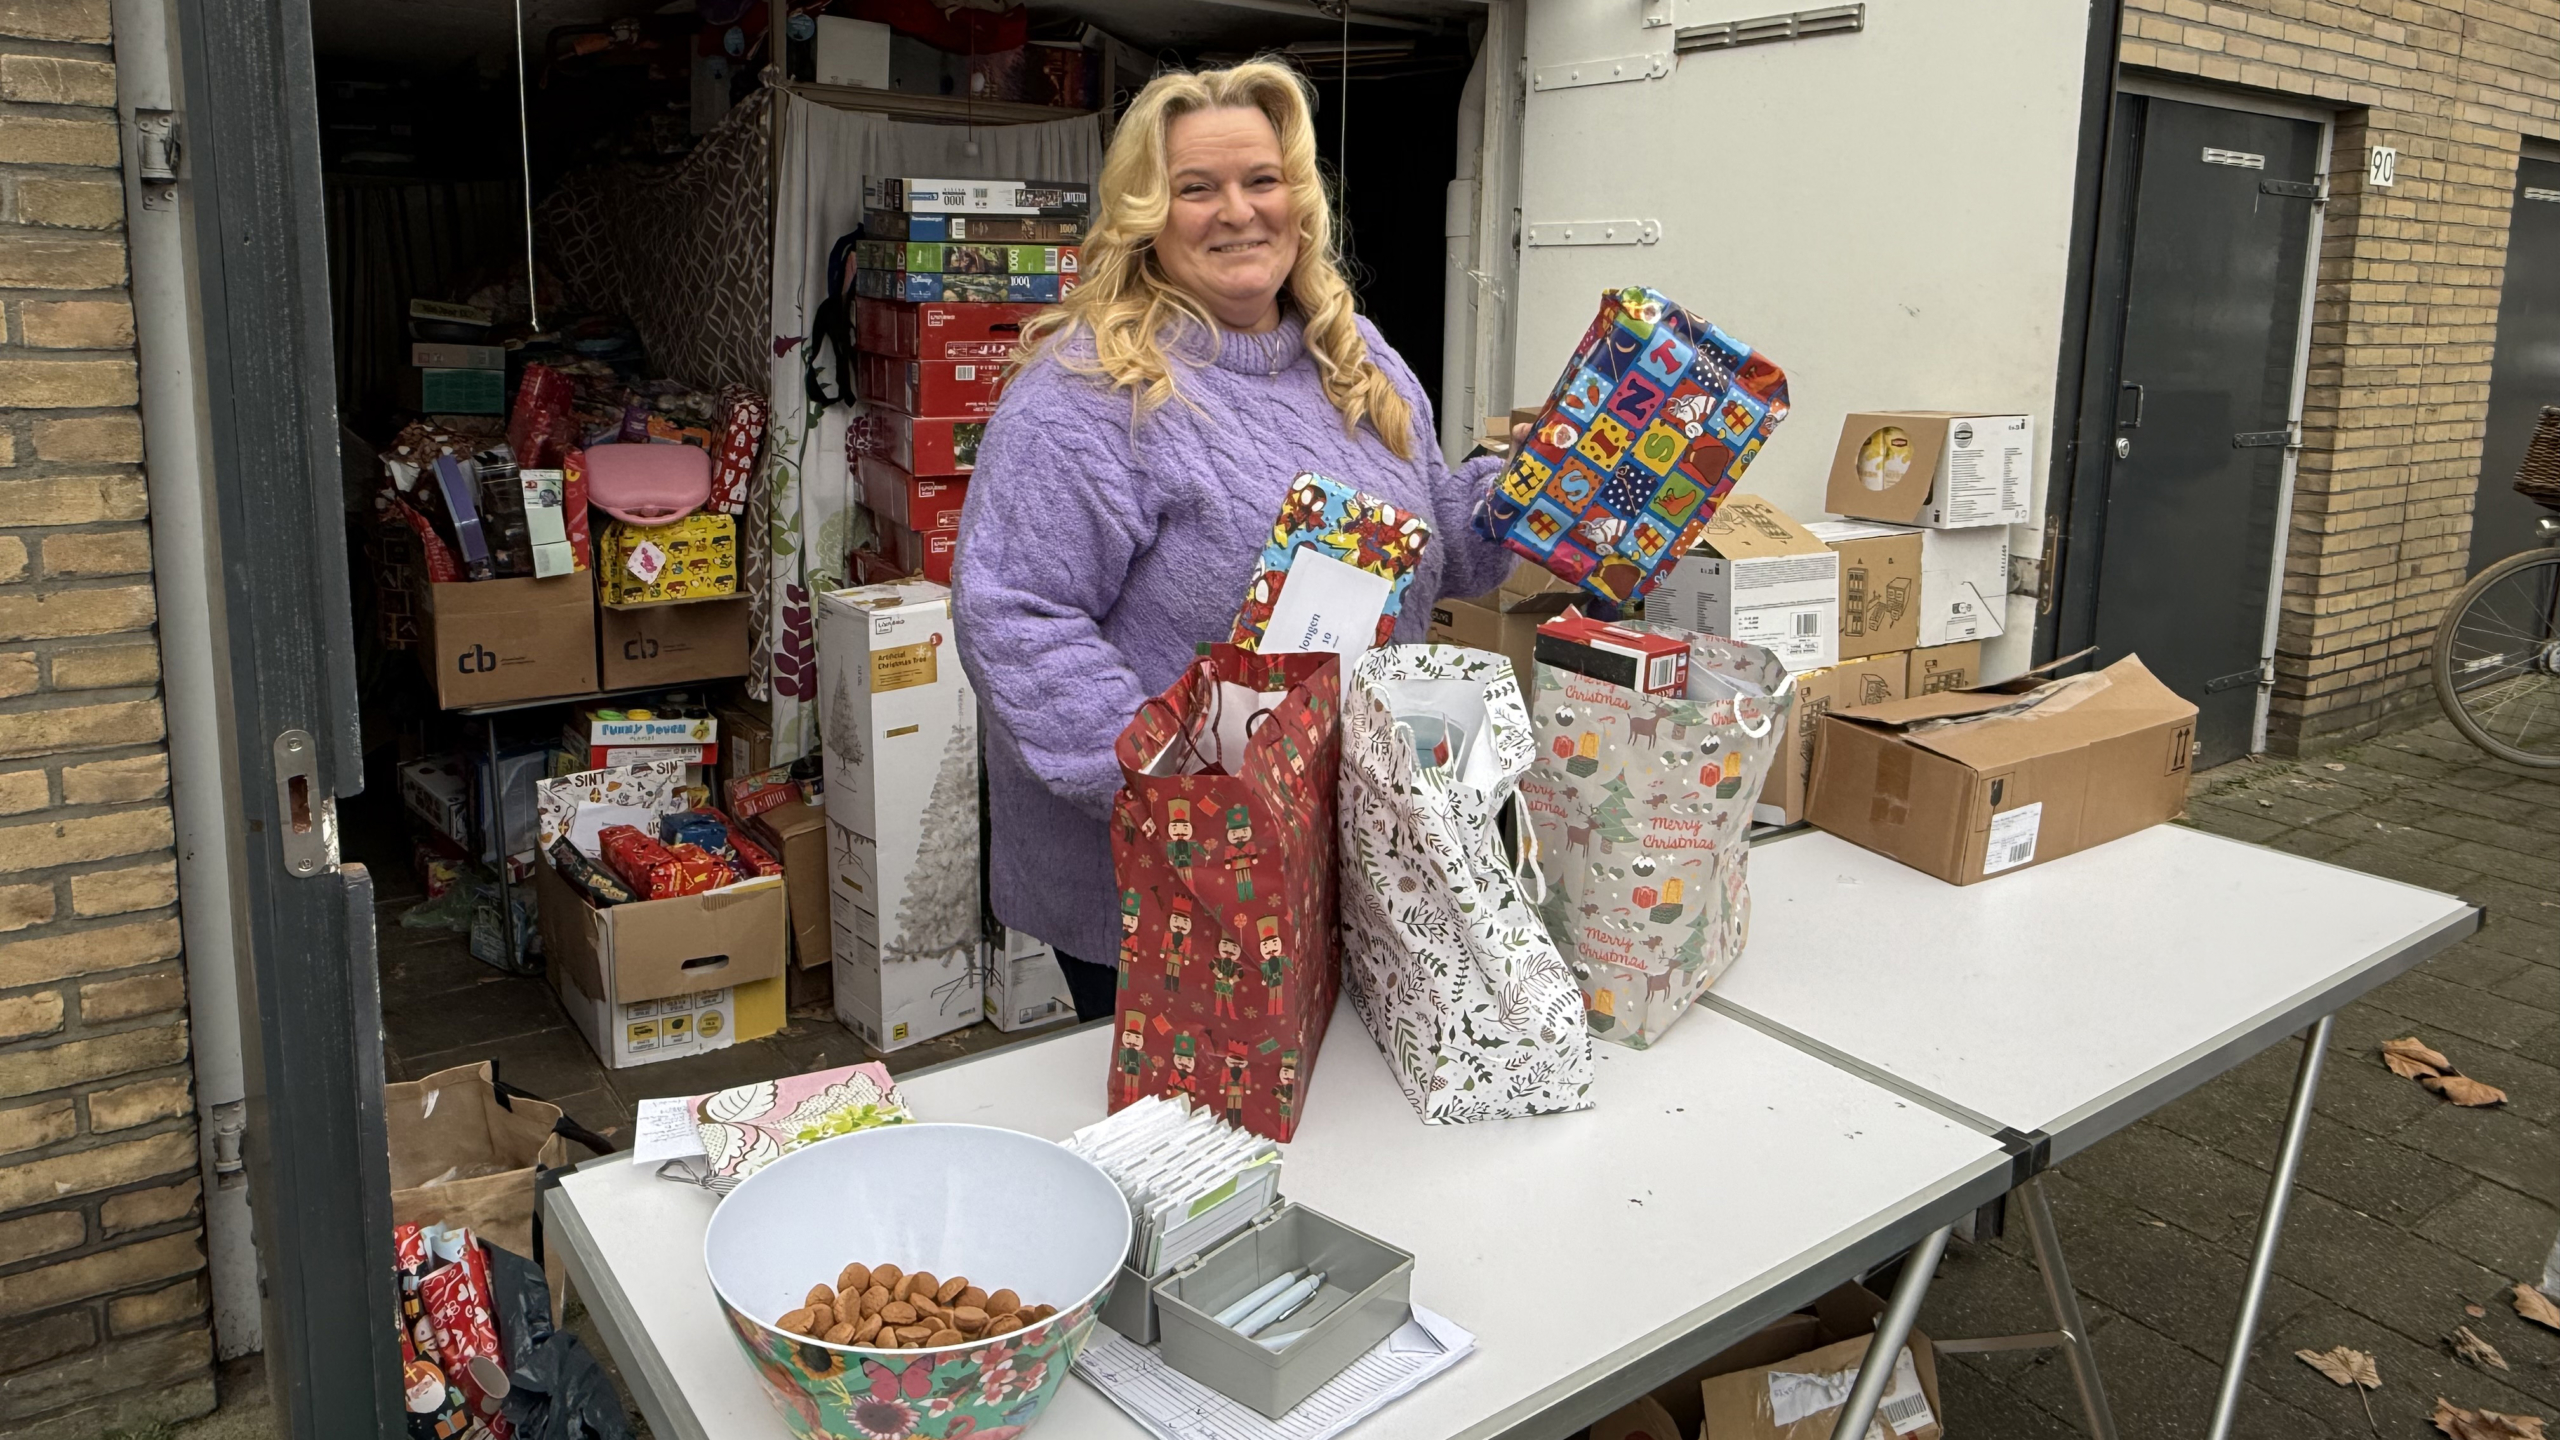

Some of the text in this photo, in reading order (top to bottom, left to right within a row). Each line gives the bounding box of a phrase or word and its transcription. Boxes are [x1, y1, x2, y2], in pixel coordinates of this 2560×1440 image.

[2373, 151, 2394, 182] 90
[944, 196, 965, 206] 1000
[1059, 224, 1078, 234] 1000
[1322, 632, 1332, 645] 10
[878, 650, 906, 661] Artificial
[878, 656, 927, 670] Christmas Tree
[1565, 685, 1631, 711] Christmas
[575, 771, 605, 788] SINT
[1649, 816, 1703, 837] Merry
[1643, 834, 1716, 850] Christmas
[1583, 926, 1634, 954] Merry
[1579, 942, 1648, 971] Christmas
